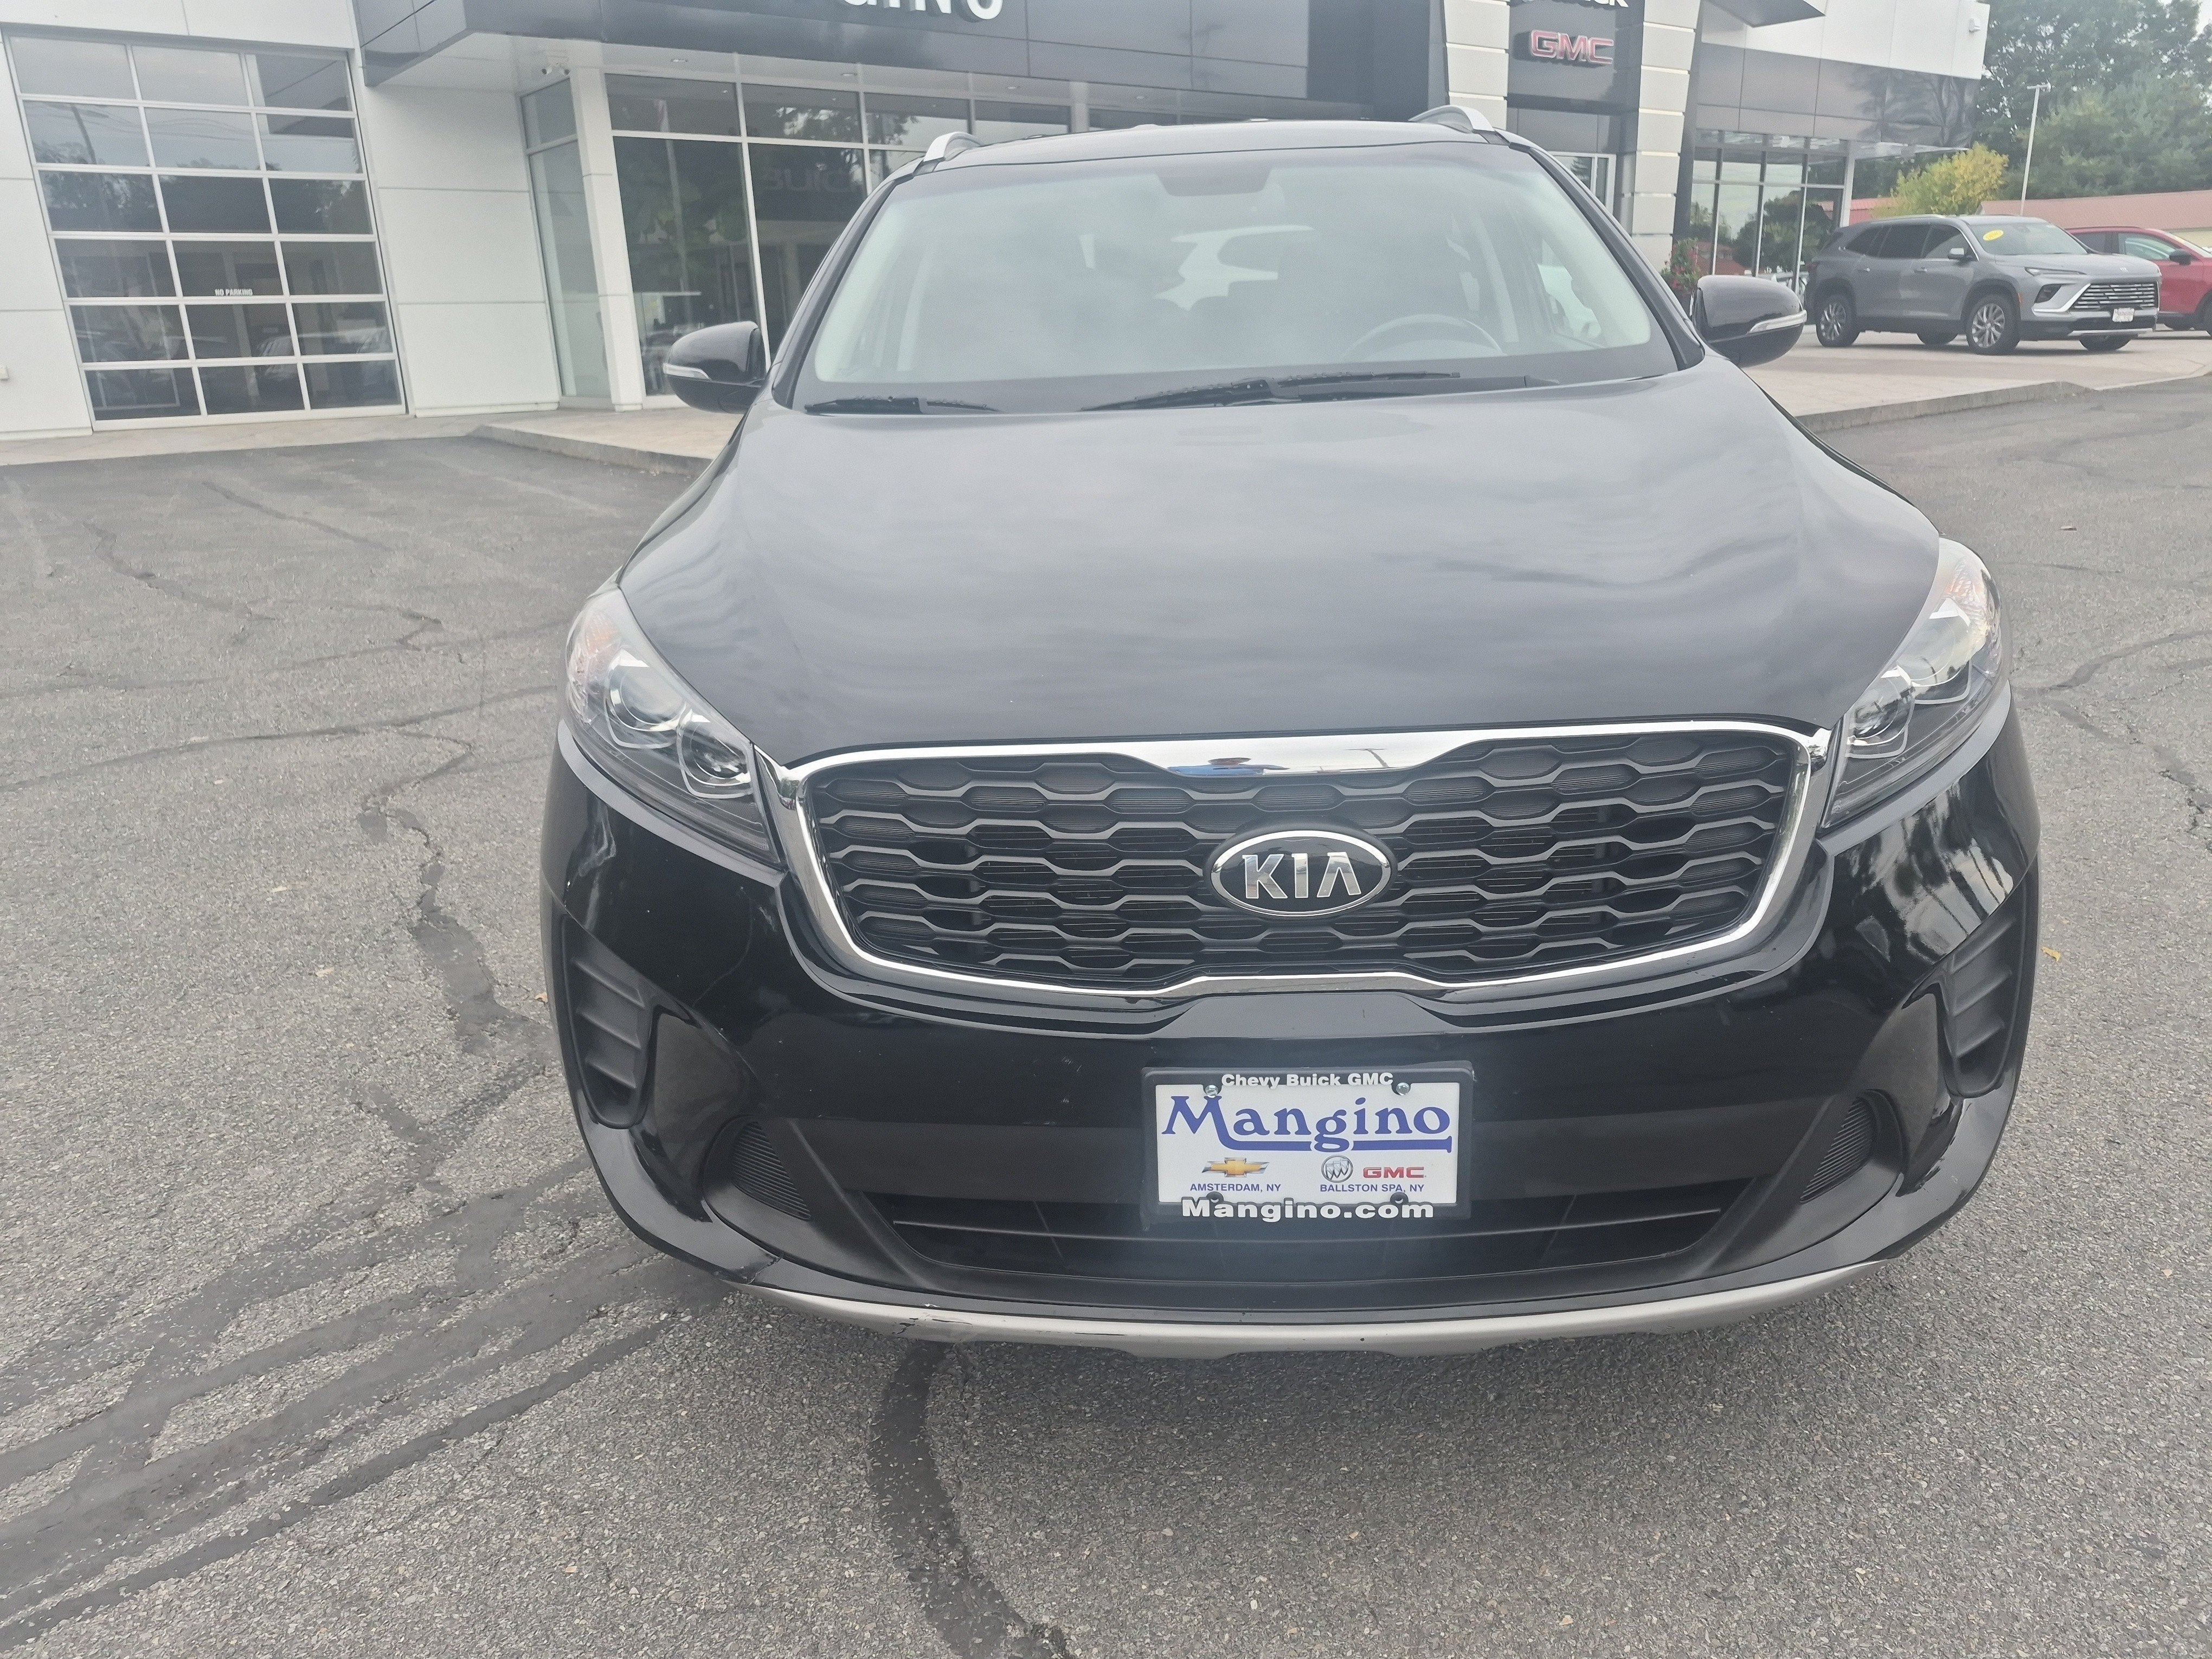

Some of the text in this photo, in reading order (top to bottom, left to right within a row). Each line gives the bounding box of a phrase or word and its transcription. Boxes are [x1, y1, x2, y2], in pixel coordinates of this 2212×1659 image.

[1531, 29, 1614, 64] GMC
[1242, 852, 1361, 899] KIA
[1221, 1072, 1393, 1089] Chevy Buick GMC
[1161, 1095, 1452, 1153] Mangino
[1363, 1167, 1425, 1178] GMC
[1190, 1184, 1263, 1193] AMSTERDAM,
[1381, 1184, 1406, 1193] SPA,
[1182, 1199, 1433, 1223] Mangino.com
